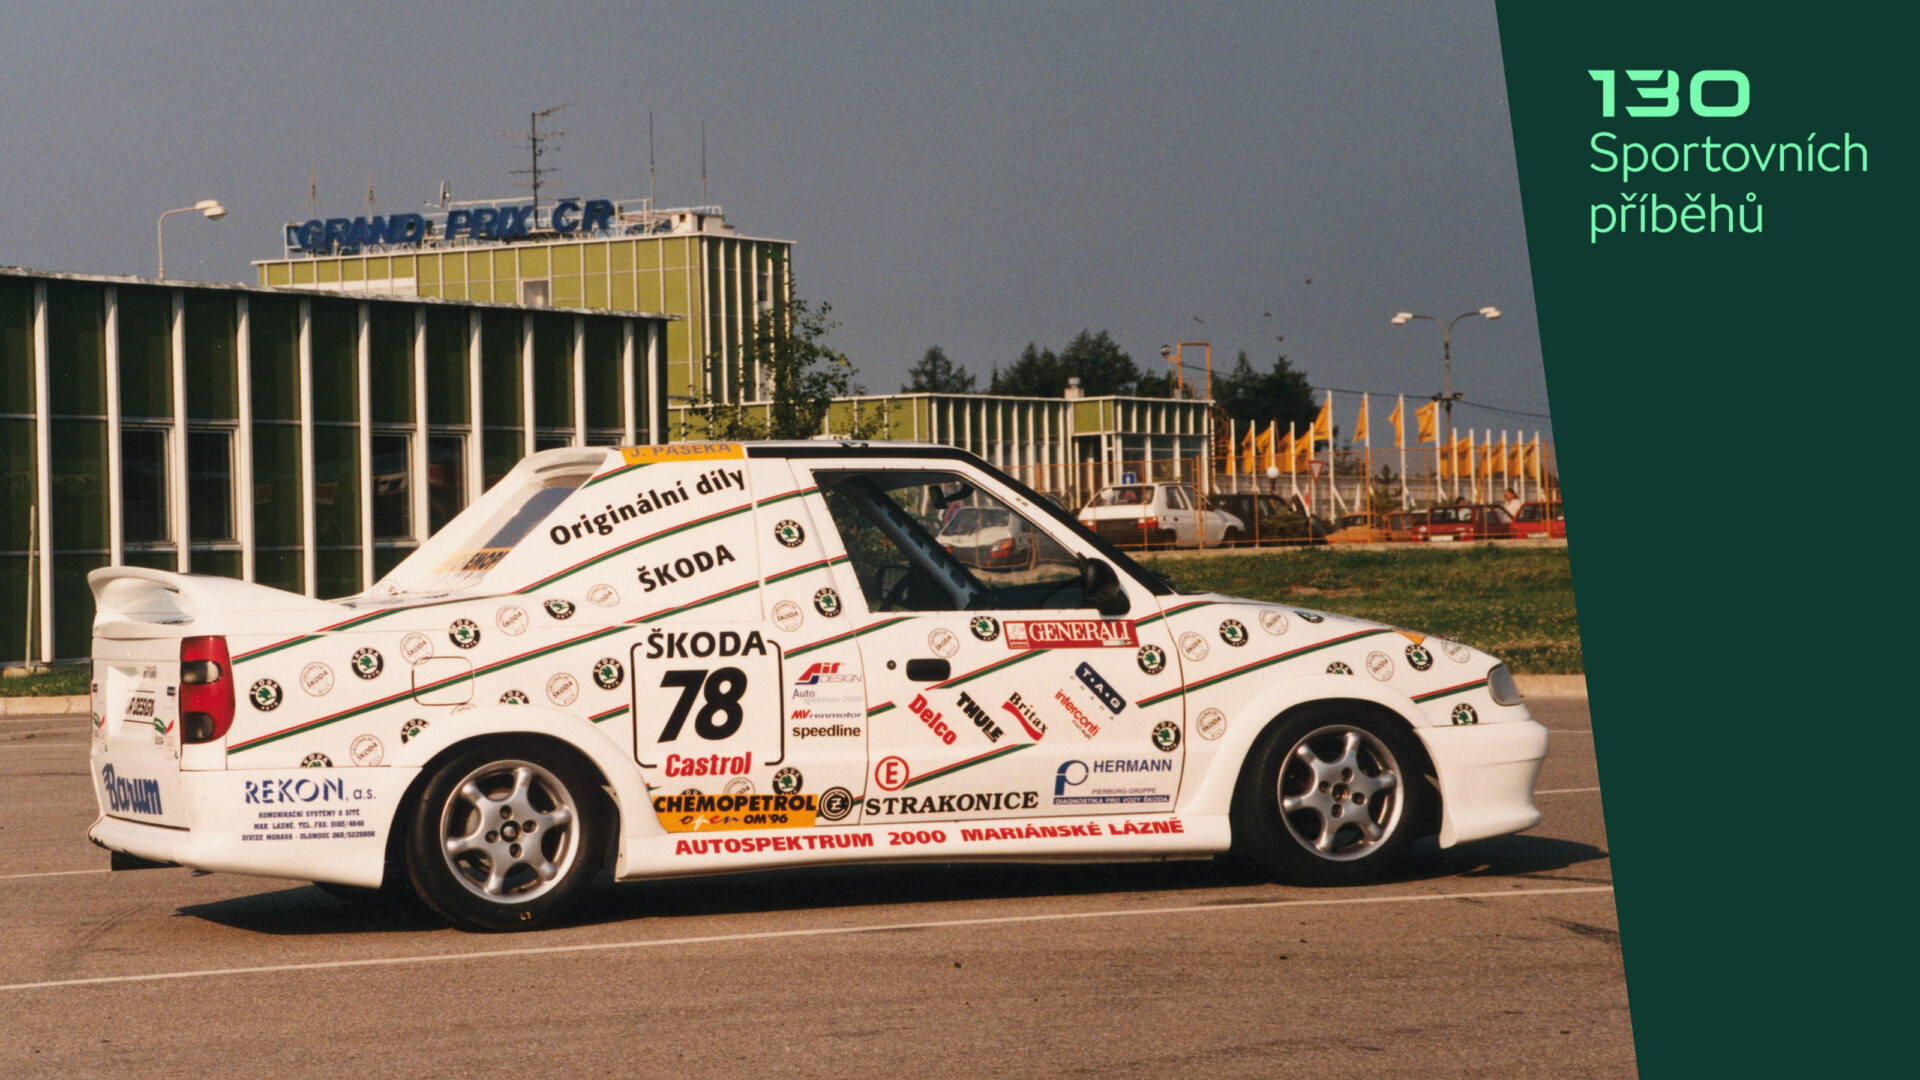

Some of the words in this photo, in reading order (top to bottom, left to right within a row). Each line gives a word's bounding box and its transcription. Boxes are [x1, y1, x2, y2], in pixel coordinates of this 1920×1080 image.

[300, 213, 426, 251] GRAND
[445, 205, 536, 240] PRIX
[552, 198, 614, 232] ČR
[630, 448, 646, 458] J.
[650, 443, 732, 456] PASEKA
[549, 480, 690, 546] Originální
[696, 468, 746, 495] díly
[637, 544, 736, 593] ŠKODA
[646, 628, 767, 659] ŠKODA
[1029, 621, 1131, 642] GENERALI
[798, 662, 841, 681] Air
[820, 674, 862, 683] DESIGN
[657, 666, 747, 744] 78
[792, 688, 816, 700] Auto
[908, 693, 957, 745] Delco
[956, 691, 1004, 743] THULE
[1008, 692, 1048, 734] Britax
[1055, 689, 1101, 737] interconti
[792, 724, 861, 739] speedline
[665, 752, 752, 777] Castrol
[885, 762, 899, 784] E
[1093, 759, 1172, 773] HERMANN
[102, 763, 162, 815] Barum
[353, 788, 377, 800] a.s.
[1055, 797, 1104, 805] DIAGNOSTIKA
[653, 795, 818, 813] CHEMOPETROL
[865, 791, 1039, 816] STRAKONICE
[679, 814, 740, 831] open
[743, 814, 767, 824] OM
[768, 814, 788, 824] '96
[675, 833, 873, 855] AUTOSPEKTRUM
[887, 830, 947, 846] 2000
[961, 823, 1102, 842] MARIÁNSKÉ
[1108, 816, 1184, 836] LÁZNĚ
